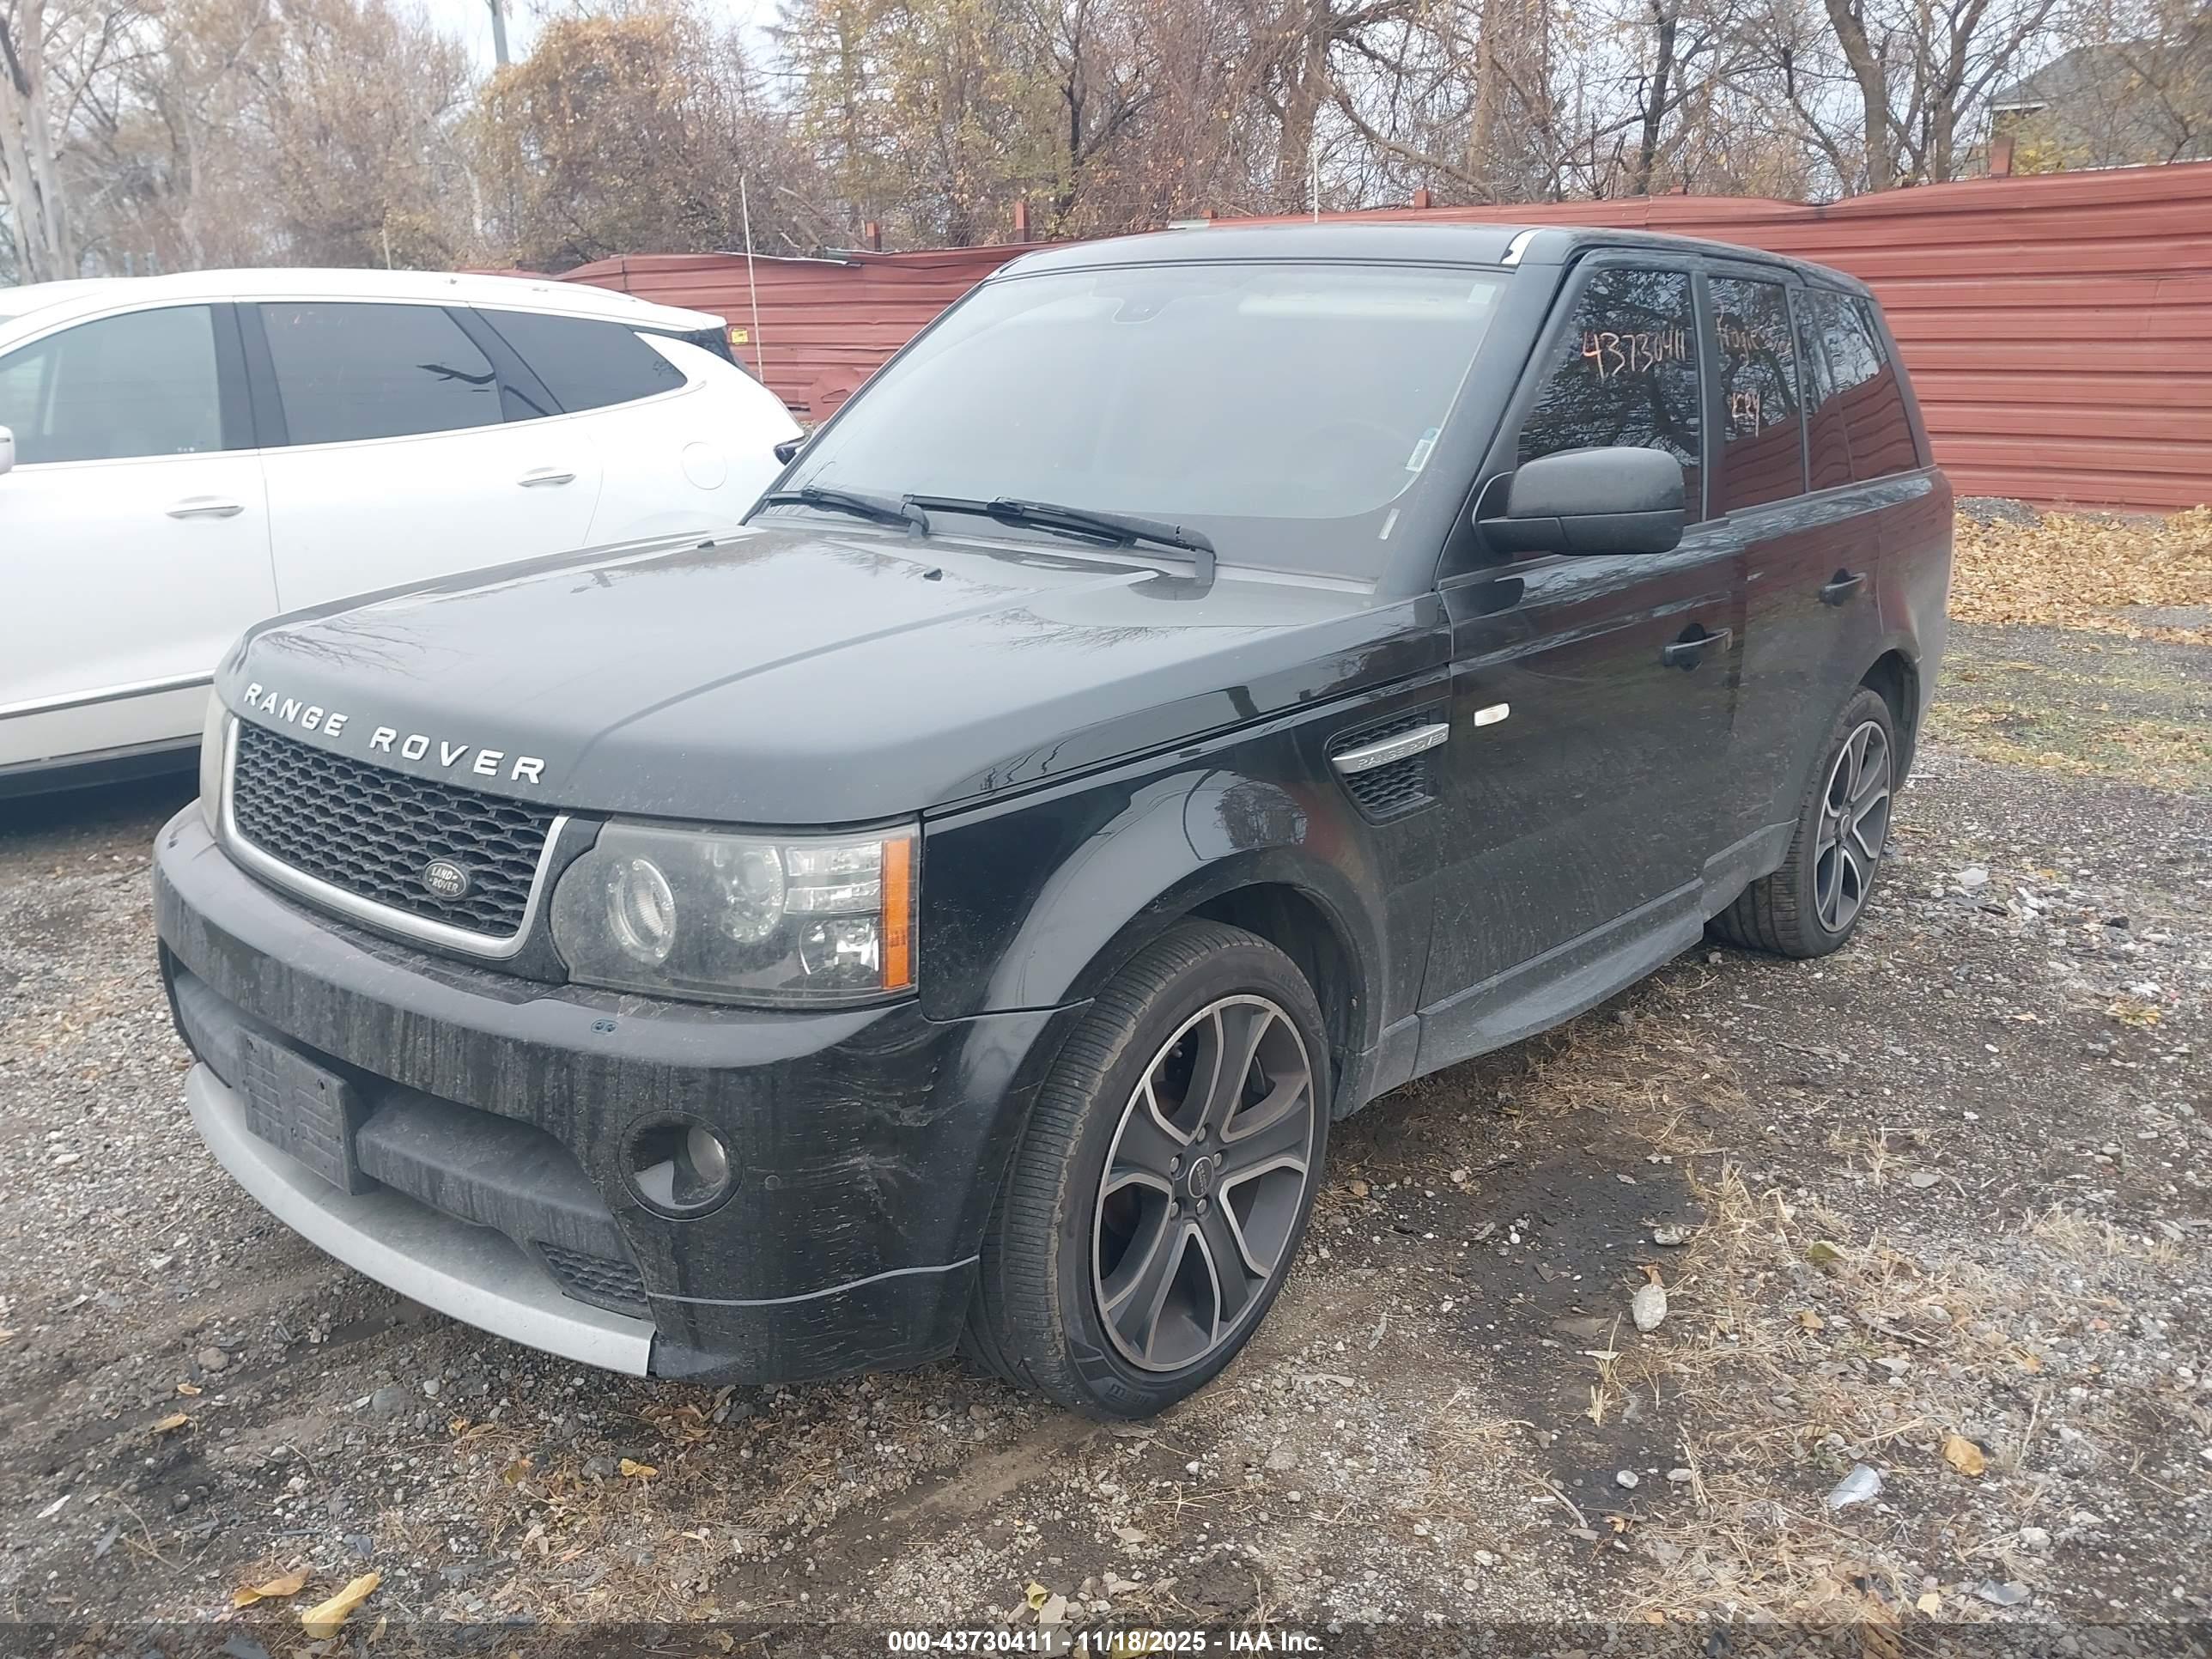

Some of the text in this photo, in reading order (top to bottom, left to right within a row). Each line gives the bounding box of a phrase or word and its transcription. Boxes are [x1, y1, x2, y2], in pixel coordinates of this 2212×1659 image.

[1580, 329, 1686, 379] 43730411
[244, 683, 545, 784] RANGE ROVER
[431, 866, 453, 880] LAND
[432, 877, 459, 893] ROVER
